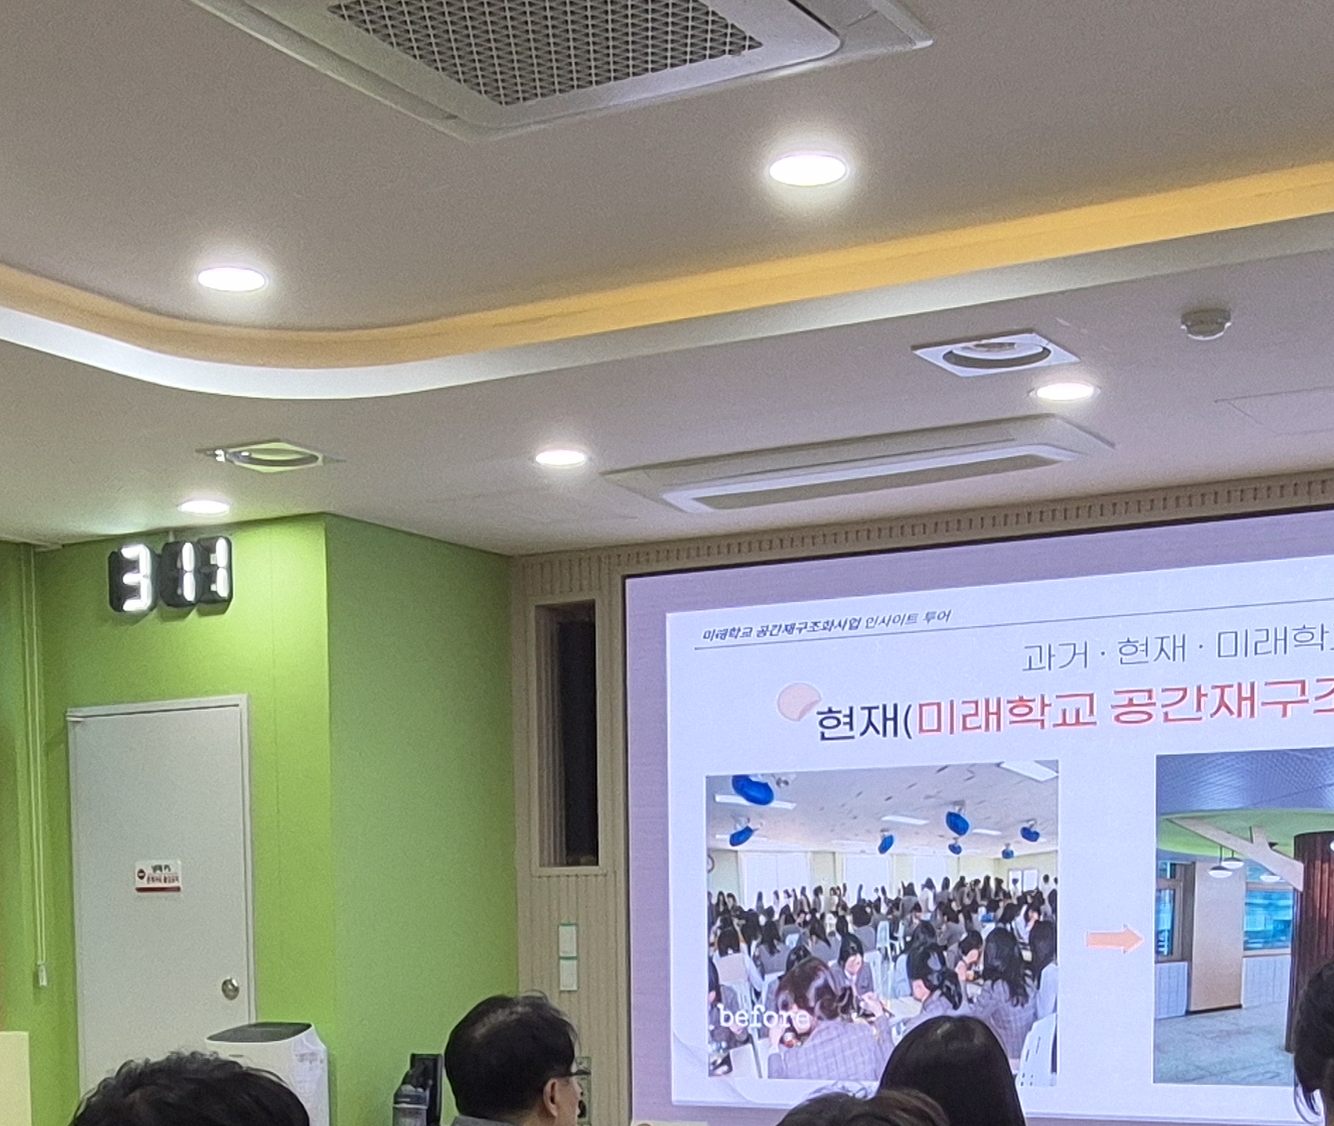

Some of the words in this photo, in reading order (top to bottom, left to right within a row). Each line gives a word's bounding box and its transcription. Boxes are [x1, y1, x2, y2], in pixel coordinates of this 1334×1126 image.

[922, 609, 953, 624] 투어
[816, 690, 1099, 742] 현재(미래학교
[717, 1003, 811, 1029] before
